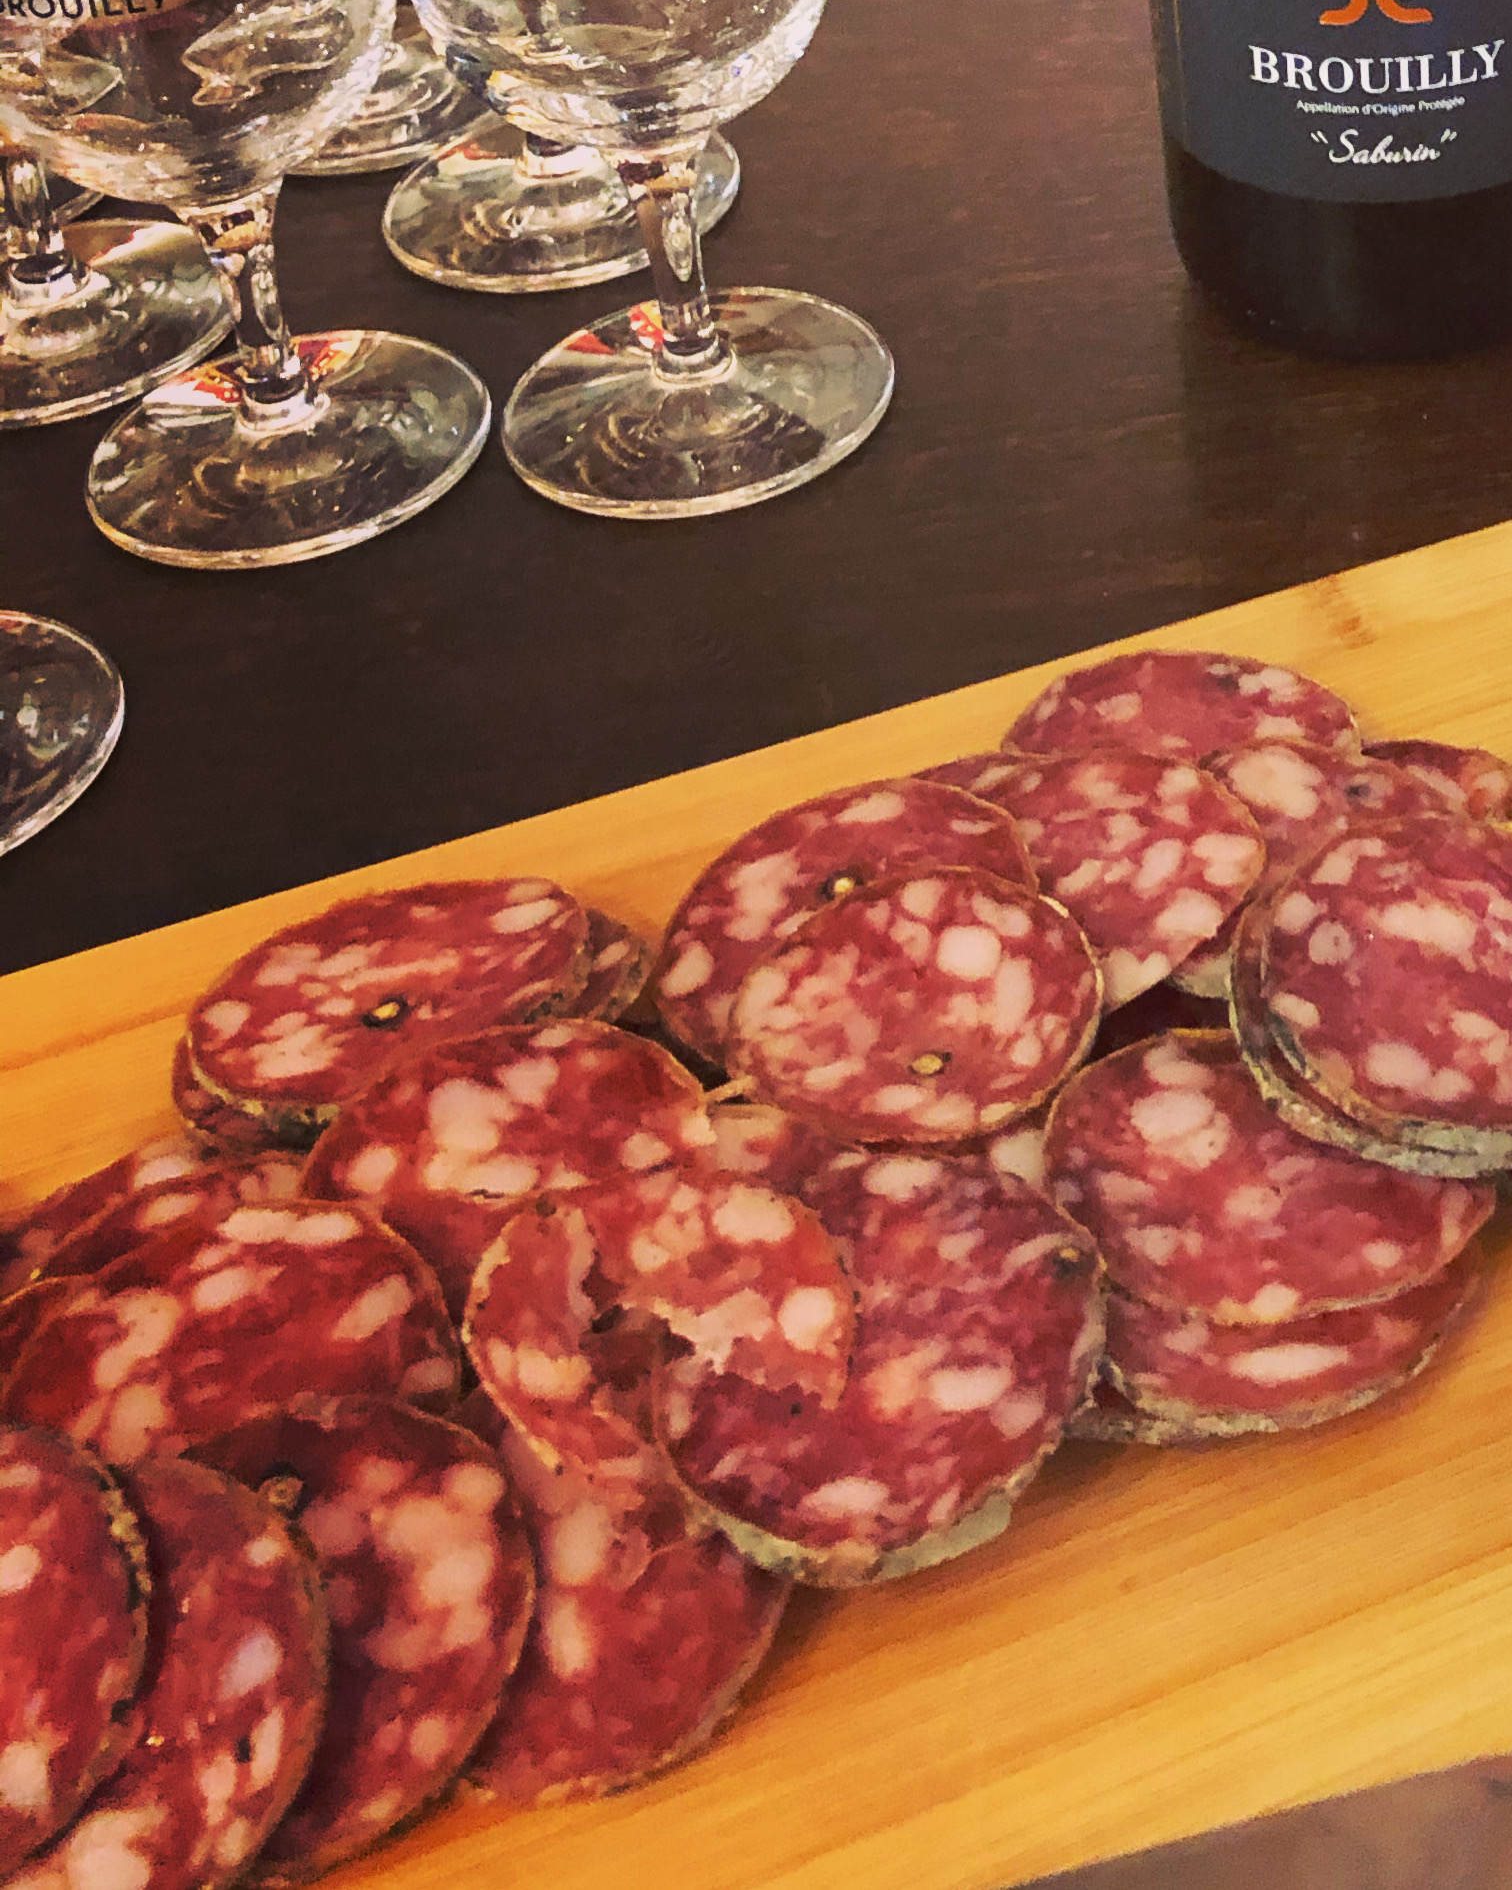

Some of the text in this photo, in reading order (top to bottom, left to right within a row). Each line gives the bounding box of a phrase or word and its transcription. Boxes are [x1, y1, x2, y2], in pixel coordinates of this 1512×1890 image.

[1248, 39, 1505, 94] BROUILLY
[1296, 99, 1360, 115] Appellation
[1361, 101, 1416, 117] d'Origine
[1310, 128, 1458, 164] "Saburin"
